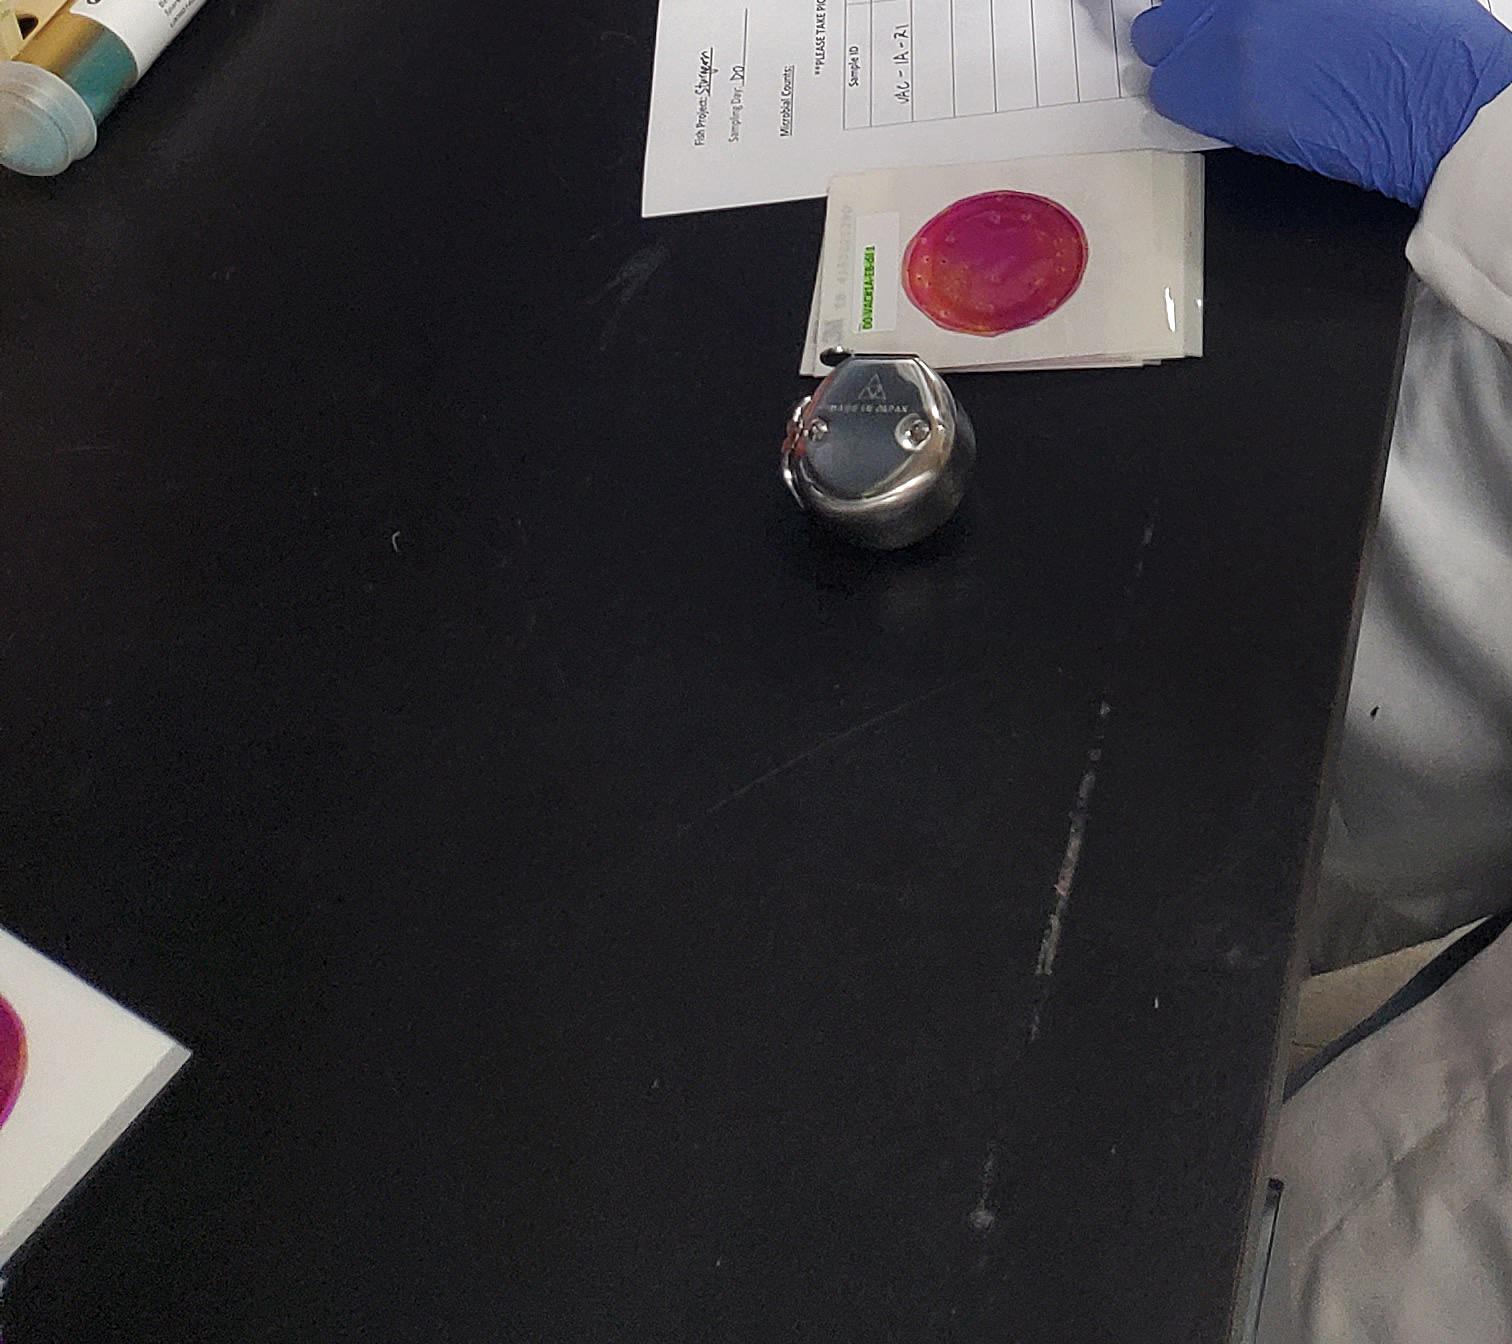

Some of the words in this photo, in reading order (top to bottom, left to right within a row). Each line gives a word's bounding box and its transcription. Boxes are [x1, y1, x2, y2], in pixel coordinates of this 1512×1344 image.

[815, 12, 827, 35] TAKE
[847, 57, 861, 88] Sample
[728, 104, 745, 143] Sampling
[779, 98, 794, 137] Microbial
[694, 129, 707, 146] Fish
